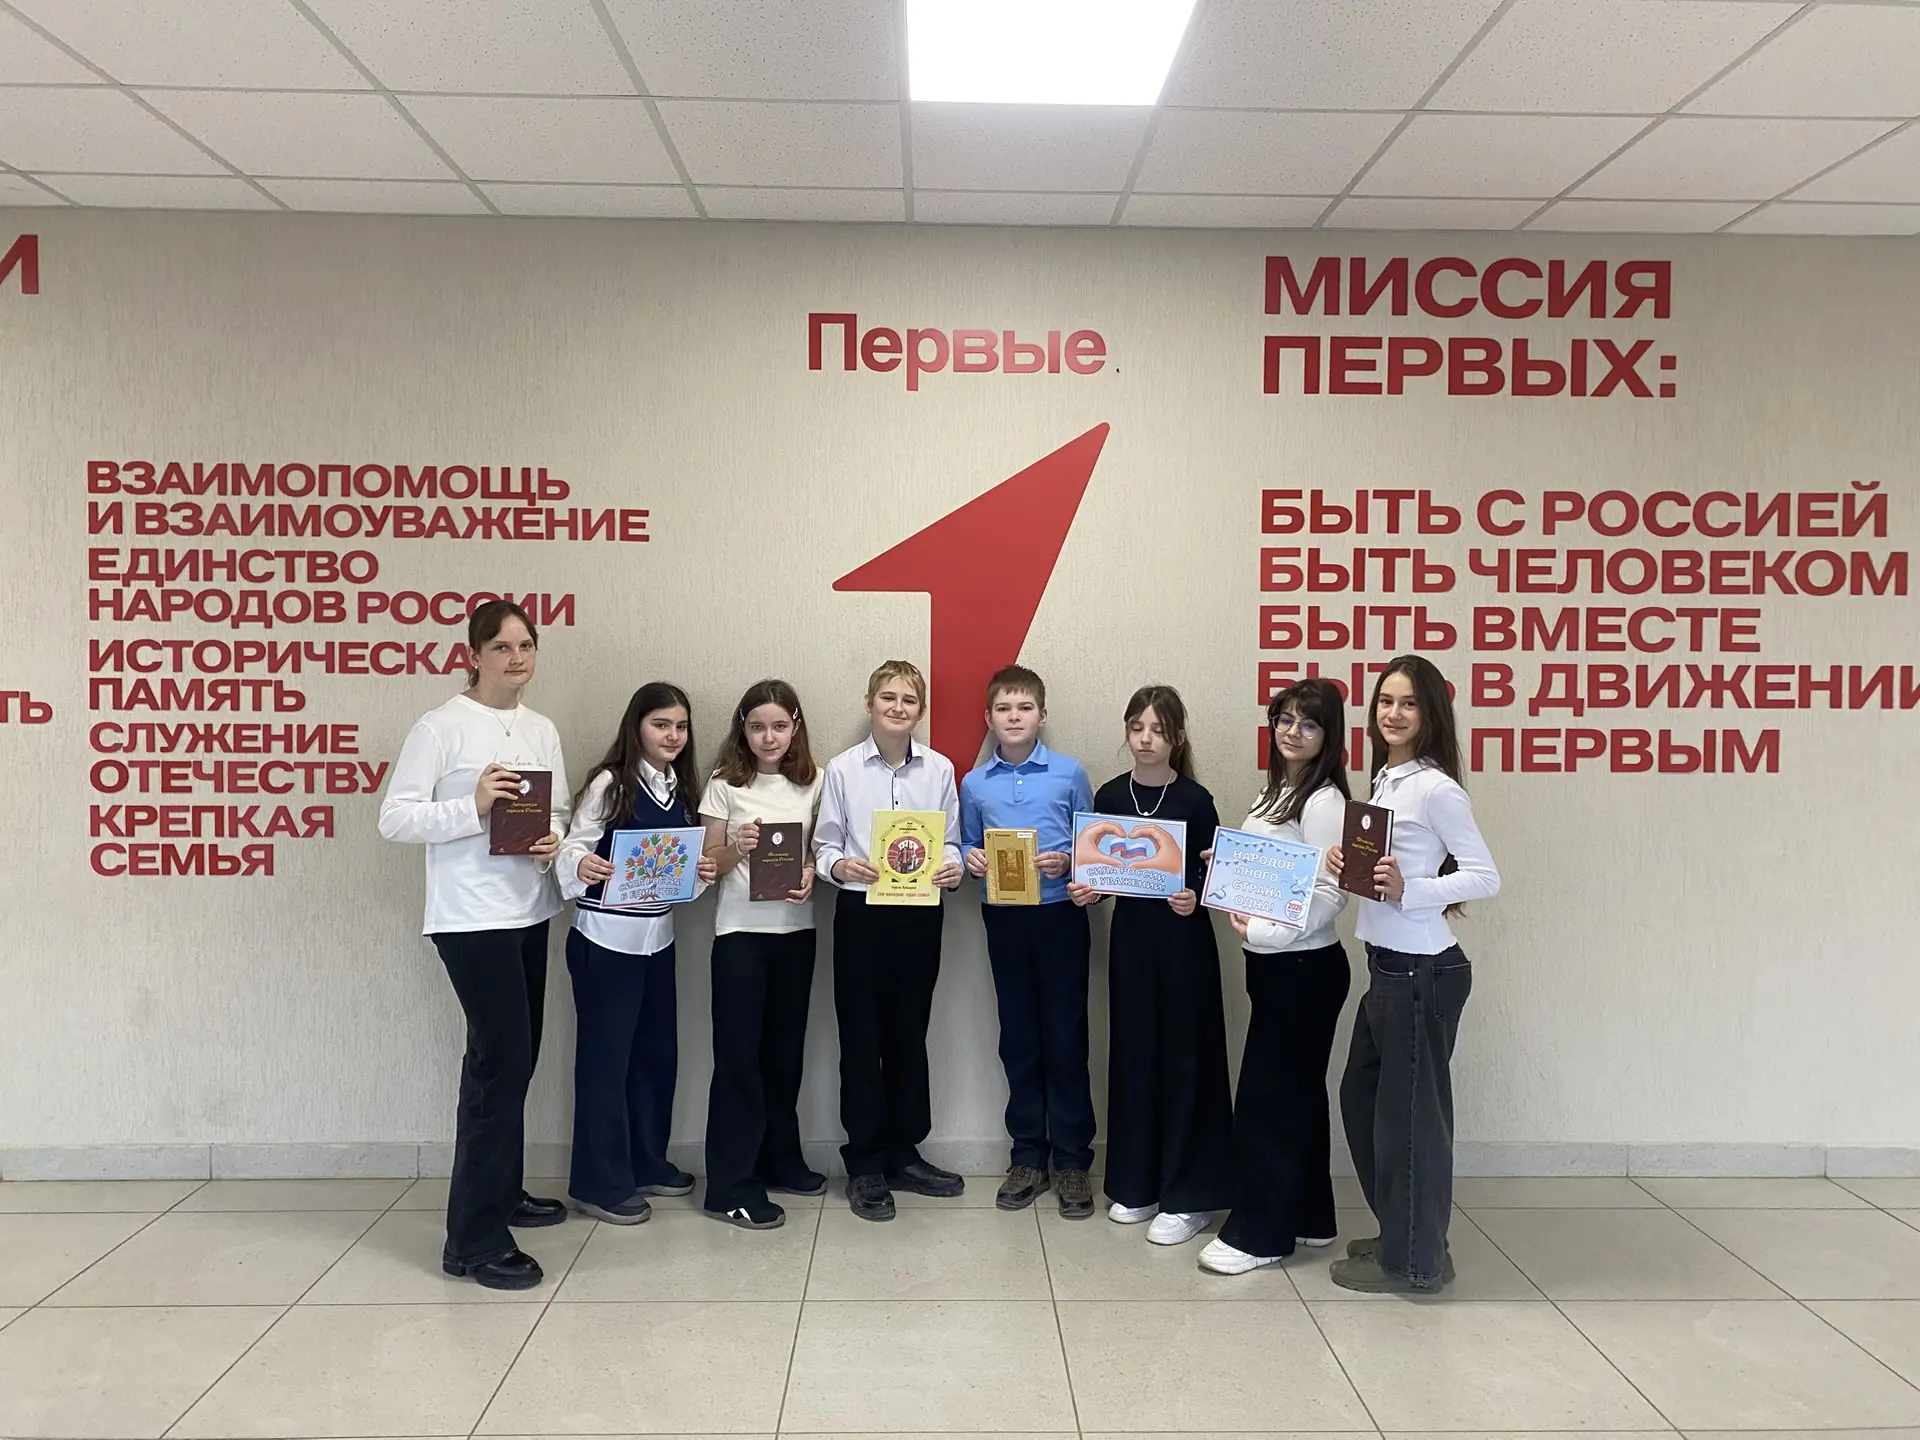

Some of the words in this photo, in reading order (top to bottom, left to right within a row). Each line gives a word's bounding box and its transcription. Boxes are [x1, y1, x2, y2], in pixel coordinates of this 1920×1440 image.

[1264, 256, 1671, 320] МИССИЯ
[808, 312, 1107, 392] Первые
[1263, 335, 1677, 398] ПЕРВЫХ:
[87, 460, 571, 504] ВЗАИМОПОМОЩЬ
[88, 501, 124, 535] И
[135, 503, 650, 543] ВЗАИМОУВАЖЕНИЕ
[1261, 489, 1462, 535] БЫТЬ
[1477, 489, 1526, 537] С
[1542, 480, 1888, 538] РОССИЕЙ
[88, 547, 379, 588] ЕДИНСТВО
[1259, 547, 1457, 594] БЫТЬ
[1468, 548, 1908, 597] ЧЕЛОВЕКОМ
[88, 588, 347, 630] НАРОДОВ
[1259, 605, 1458, 651] БЫТЬ
[1472, 606, 1761, 653] ВМЕСТЕ
[88, 639, 476, 676] ИСТОРИЧЕСКА
[88, 677, 306, 713] ПАМЯТЬ
[1471, 662, 1516, 708] В
[88, 721, 359, 755] СЛУЖЕНИЕ
[1470, 727, 1780, 774] ПЕРВЫМ
[88, 759, 390, 795] ОТЕЧЕСТВУ
[88, 804, 334, 839] КРЕПКАЯ
[89, 842, 274, 877] СЕМЬЯ
[1086, 866, 1118, 877] СИЛА
[1120, 866, 1166, 883] РОССИИ
[1232, 849, 1296, 871] НАРОДОВ
[1233, 865, 1279, 883] МНОГО
[1089, 877, 1098, 887] В
[1099, 877, 1167, 892] УВАЖЕНИИ!
[1232, 879, 1283, 900] СТРАНА
[1234, 894, 1276, 913] ОДНА!
